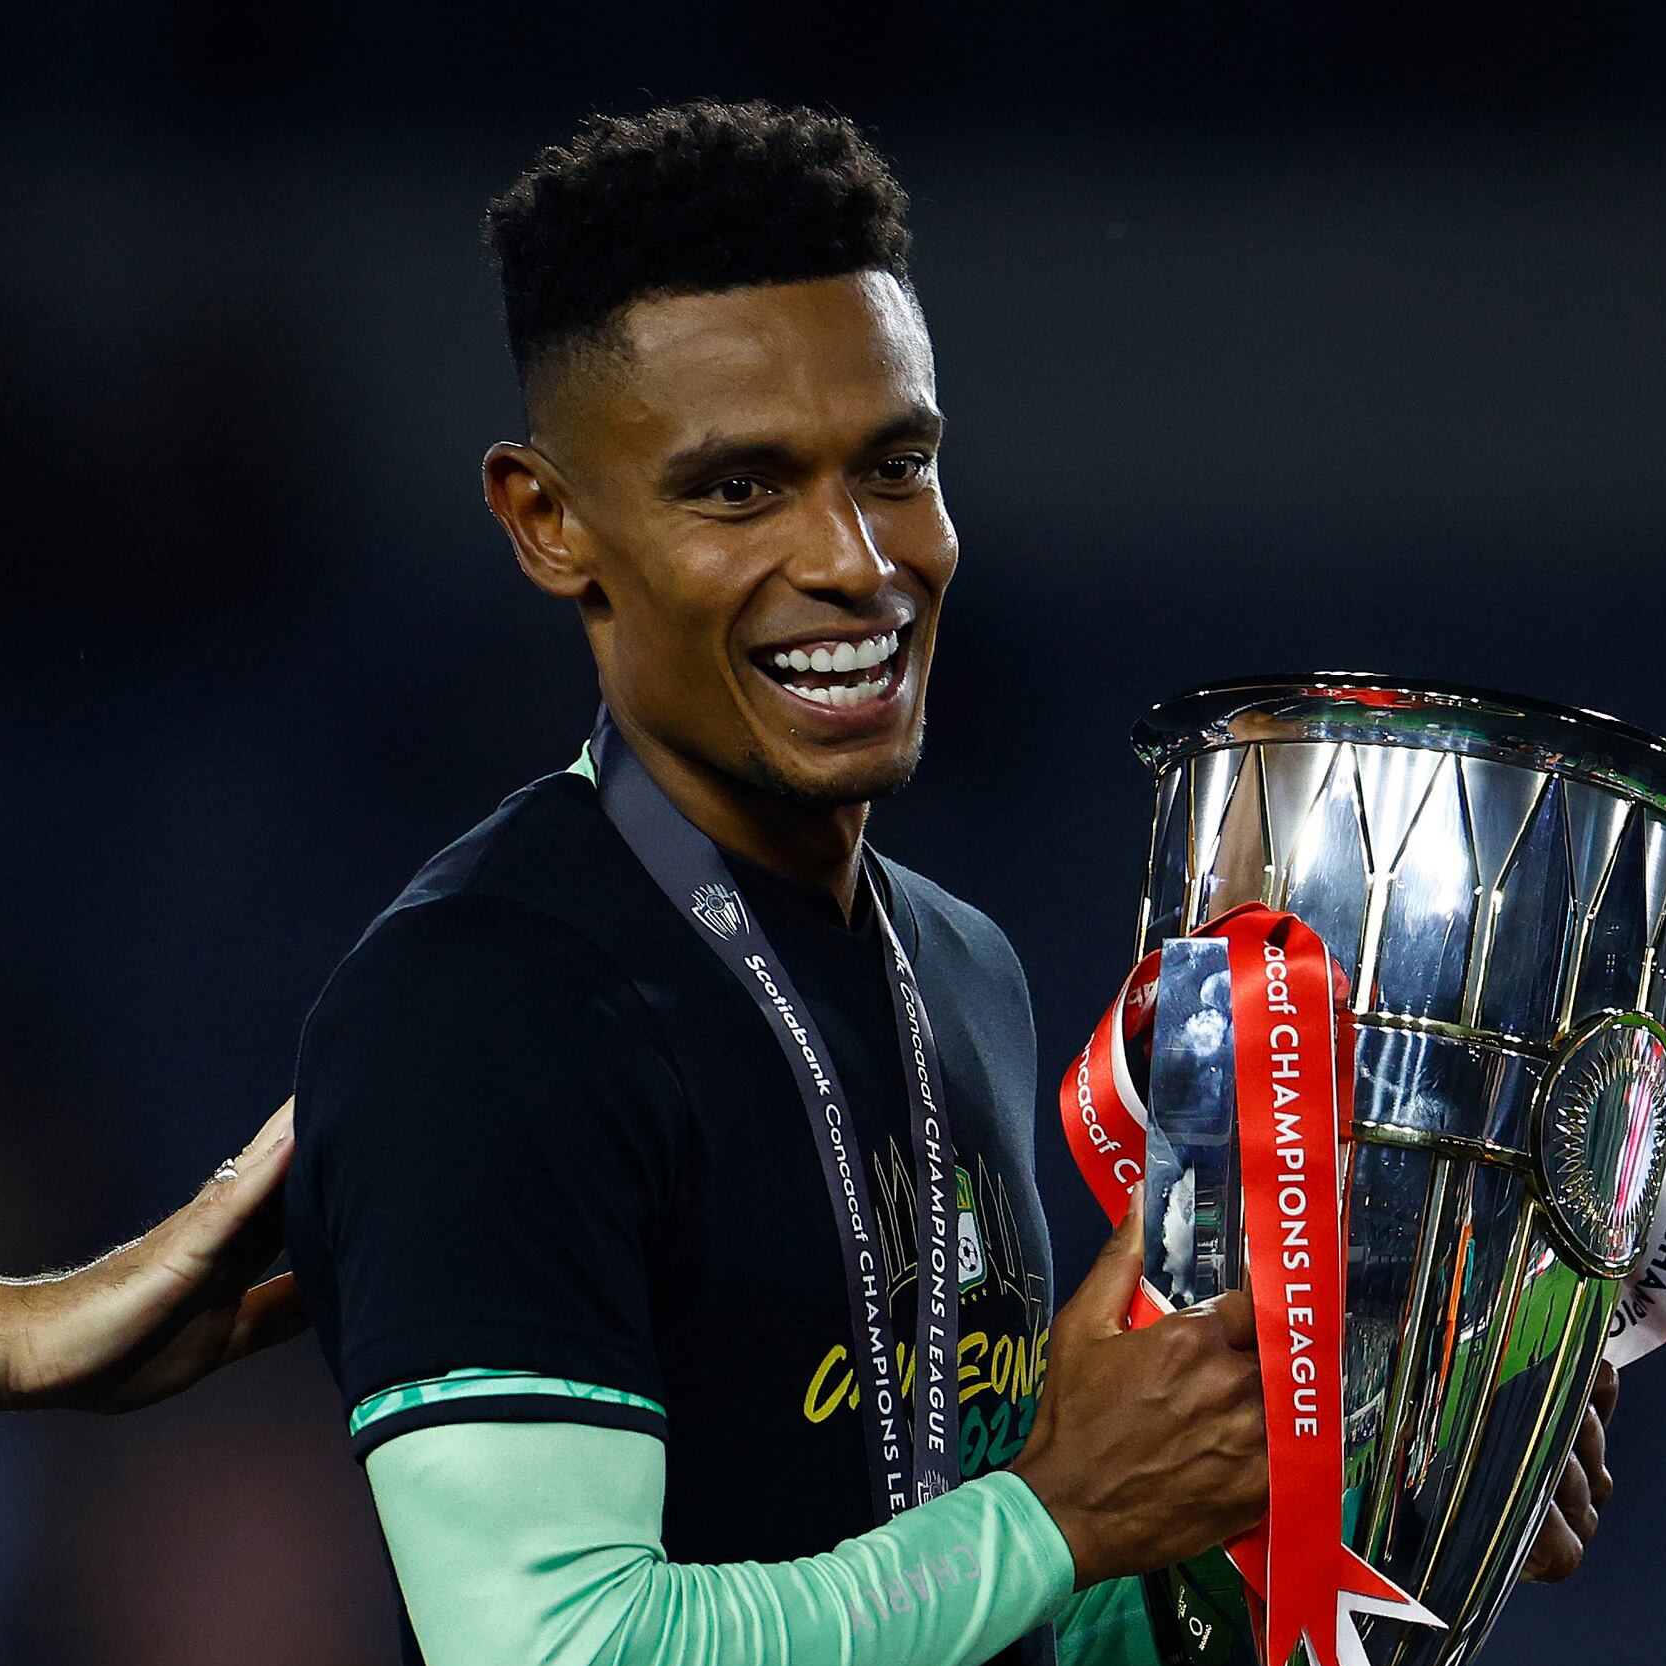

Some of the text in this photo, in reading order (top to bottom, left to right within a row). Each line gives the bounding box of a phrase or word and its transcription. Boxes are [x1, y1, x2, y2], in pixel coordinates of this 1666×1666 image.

[899, 981, 937, 1113] Concacaf
[744, 954, 831, 1097] Scotiabank
[825, 1103, 869, 1243] Concacaf
[858, 1250, 900, 1462] CHAMPIONS
[925, 1117, 947, 1318] CHAMPIONS
[1269, 1024, 1311, 1271] CHAMPIONS
[928, 1324, 946, 1454] LEAGUE
[1285, 1283, 1319, 1438] LEAGUE
